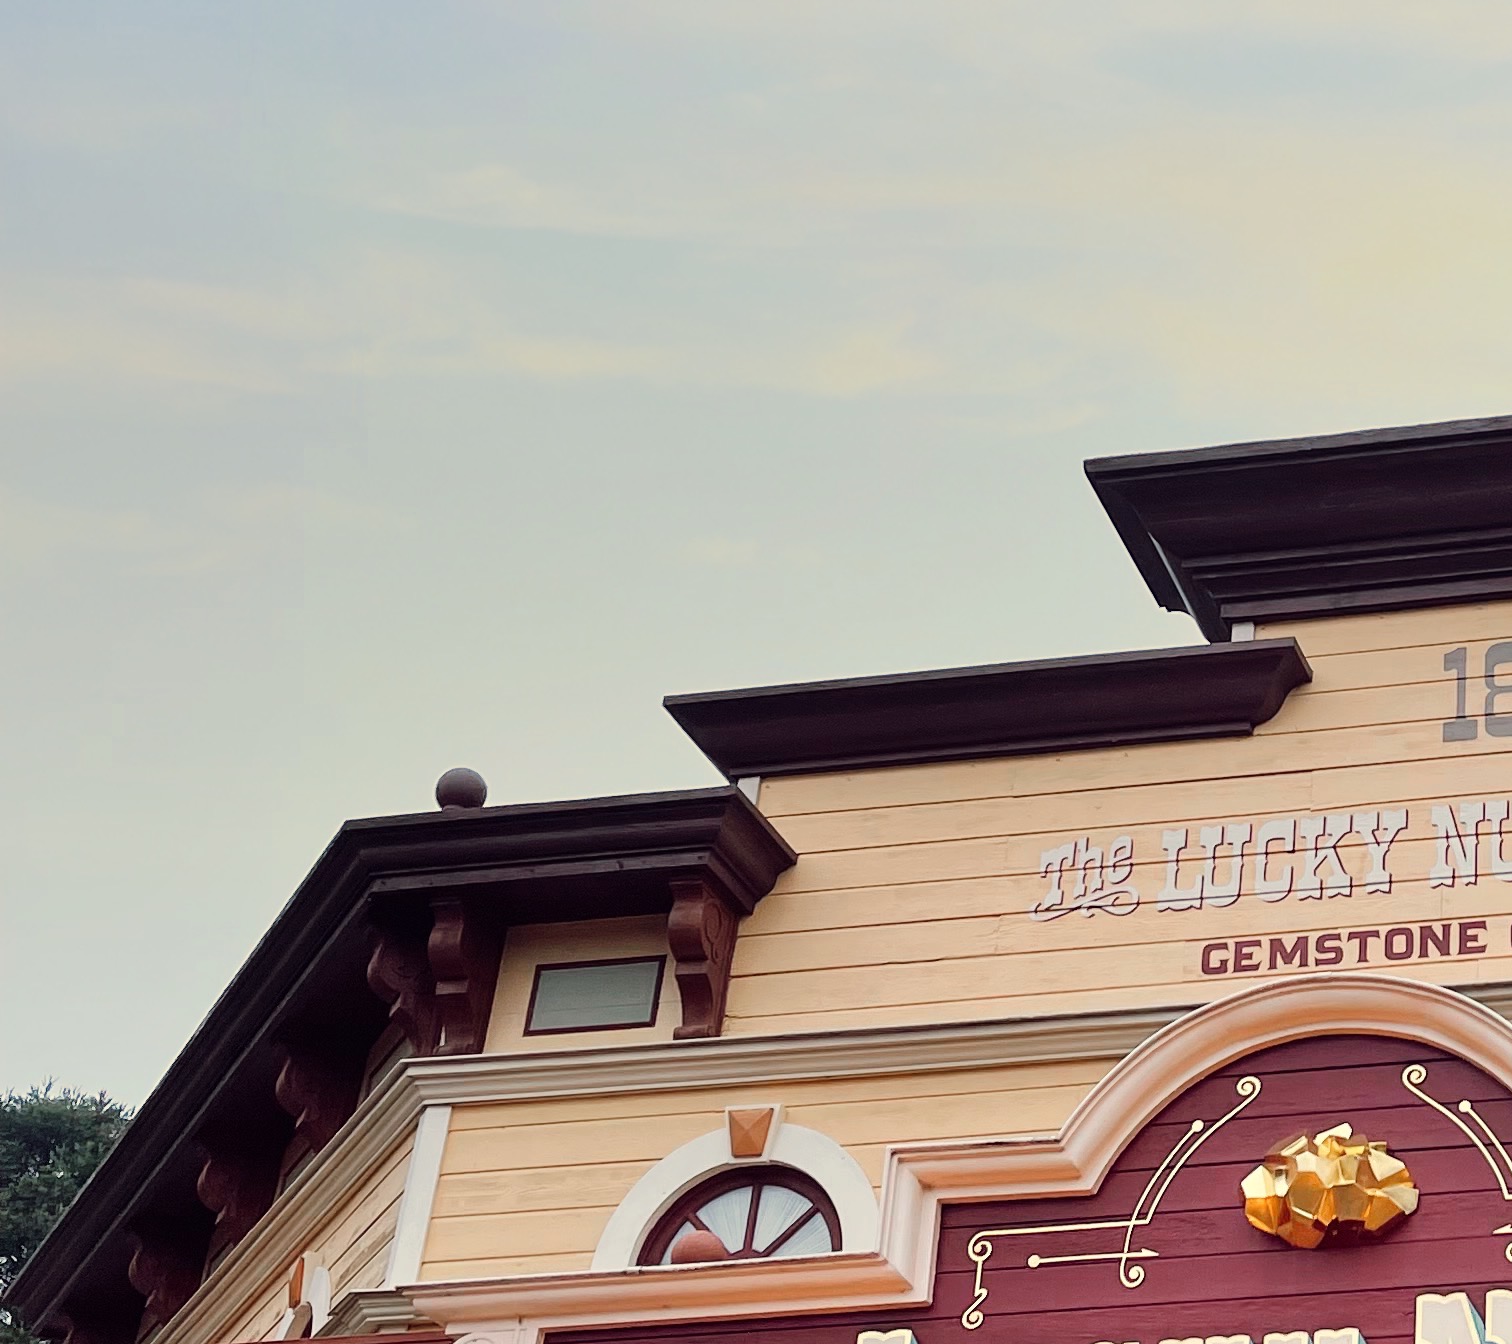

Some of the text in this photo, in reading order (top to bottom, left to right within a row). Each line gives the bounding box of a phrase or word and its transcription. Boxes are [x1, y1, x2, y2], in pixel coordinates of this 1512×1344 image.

[1030, 835, 1141, 921] The
[1155, 810, 1409, 914] LUCKY
[1200, 920, 1488, 976] GEMSTONE
